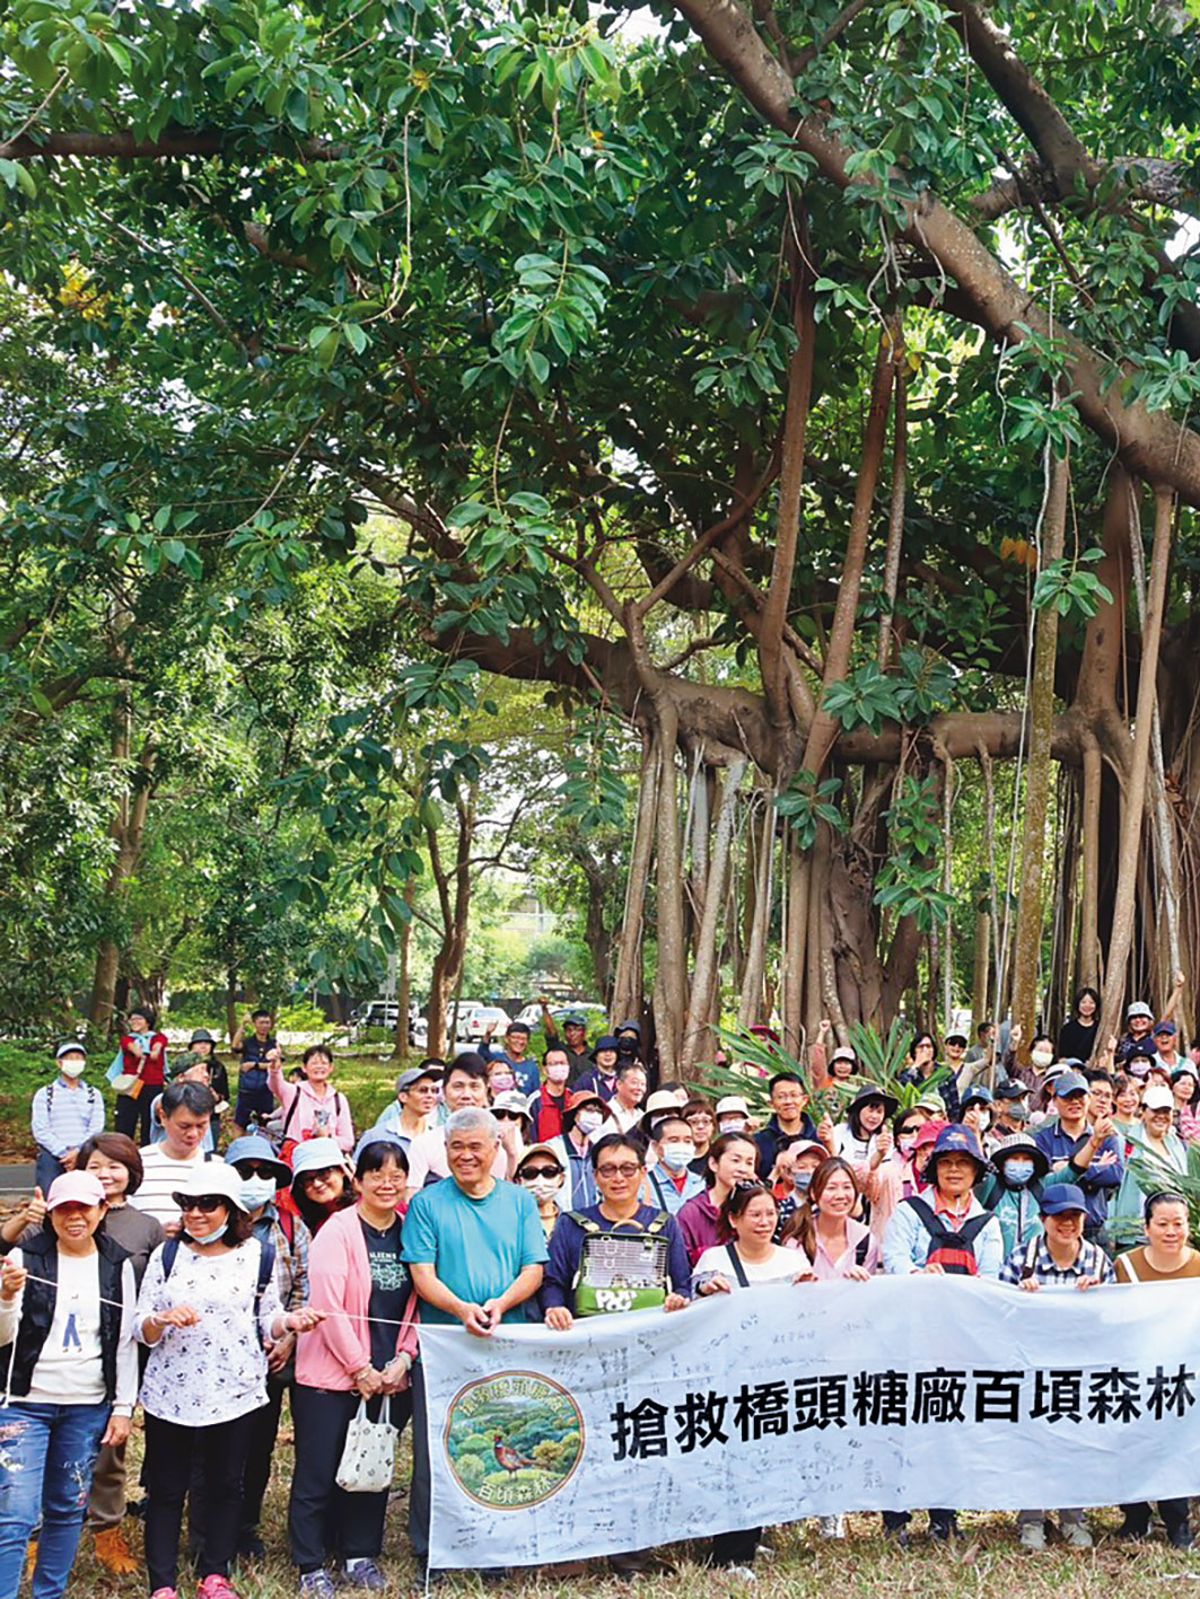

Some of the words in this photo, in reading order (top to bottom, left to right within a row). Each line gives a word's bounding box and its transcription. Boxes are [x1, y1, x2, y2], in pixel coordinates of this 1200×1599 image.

[610, 1364, 1196, 1462] 搶救橋頭糖廠百頃森林
[478, 1476, 552, 1503] 百頃森林
